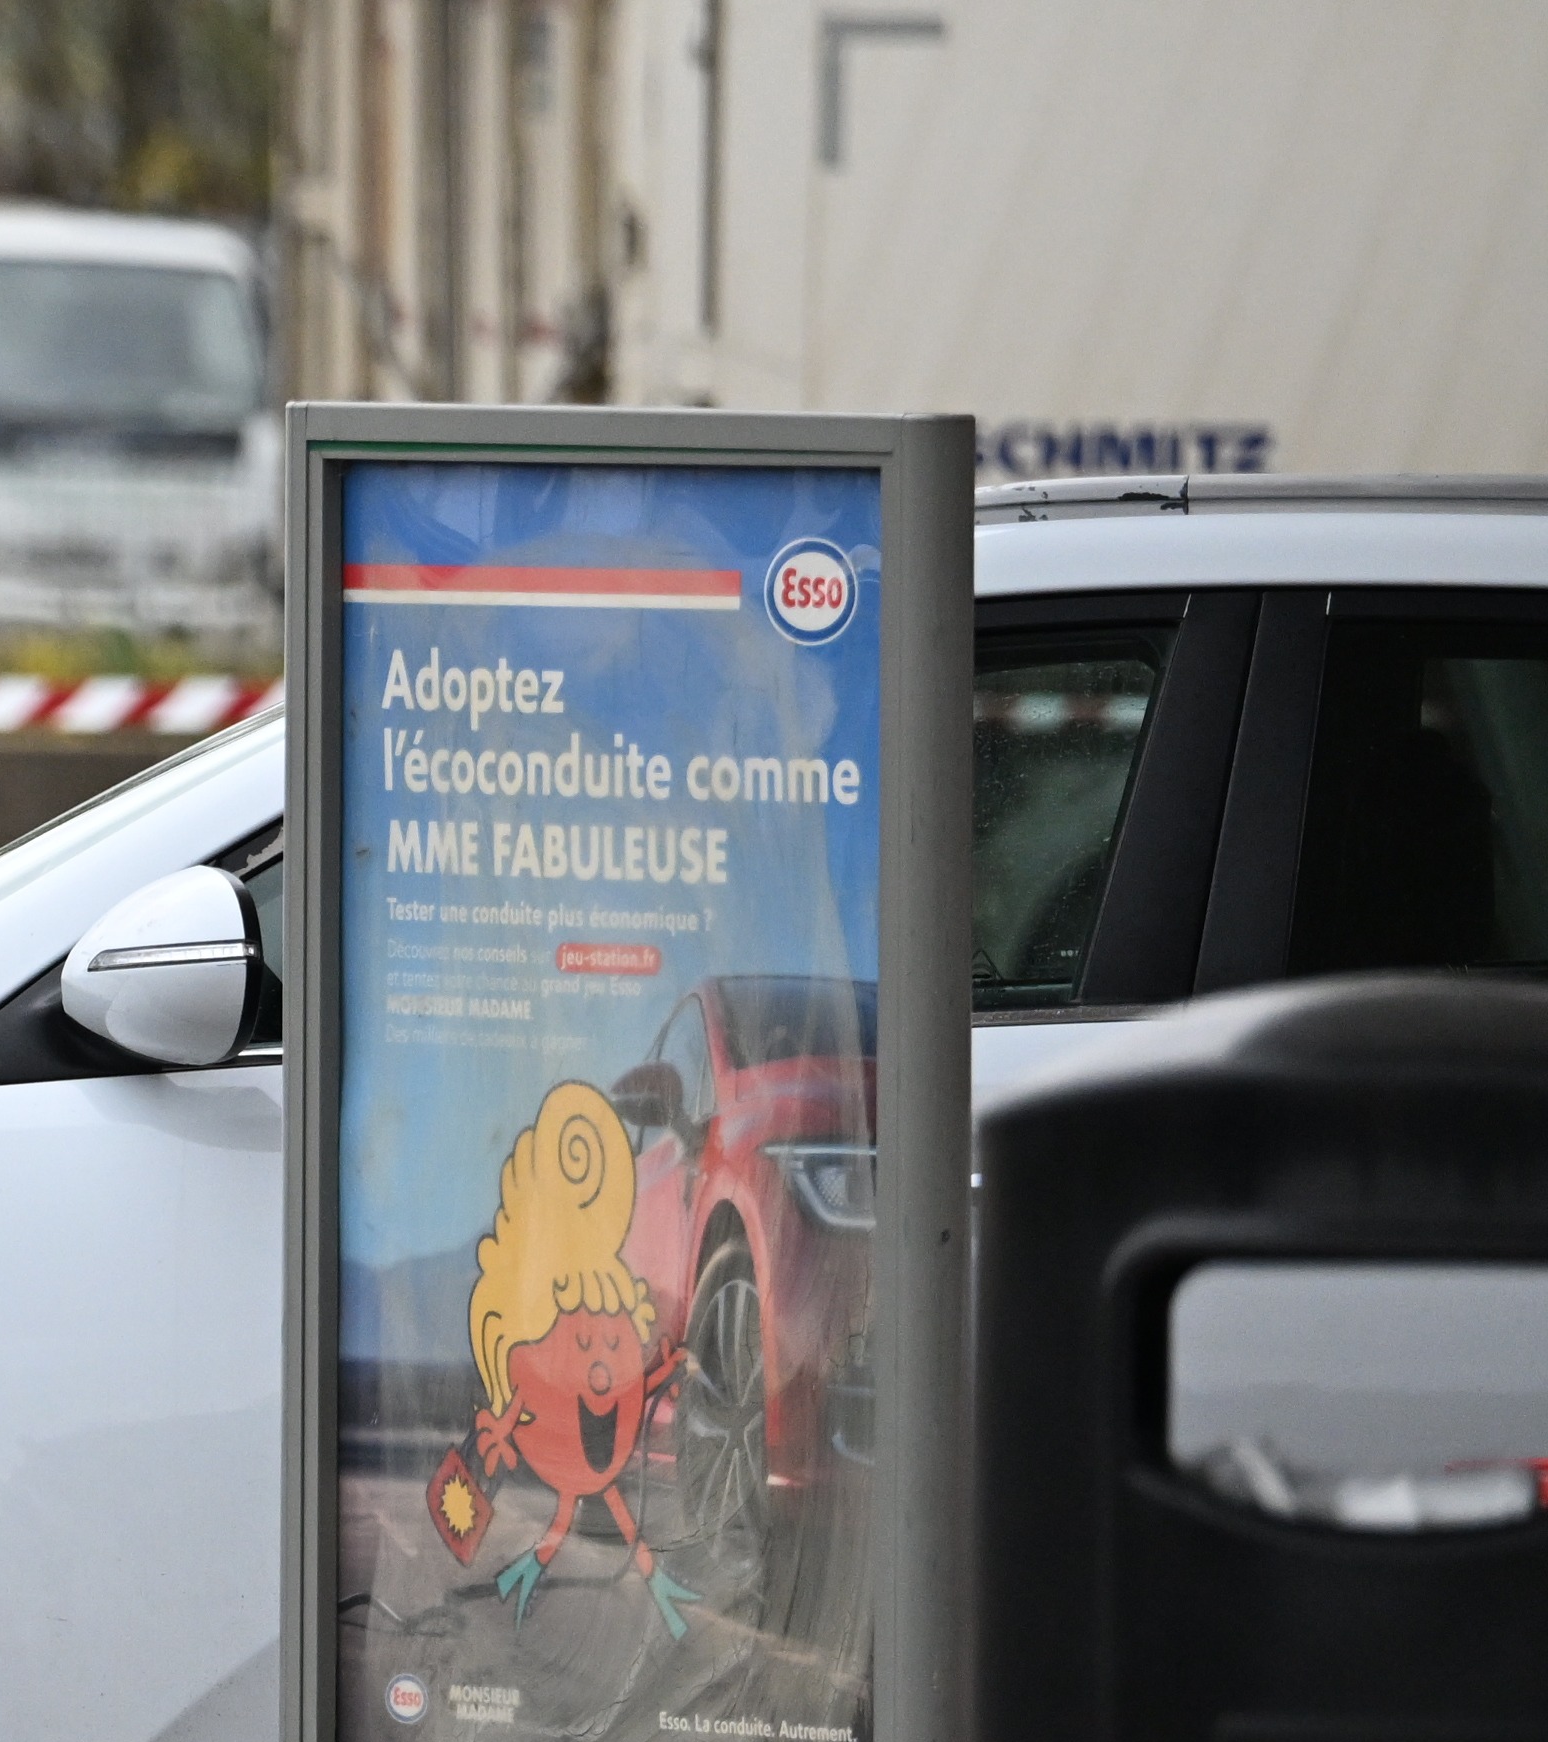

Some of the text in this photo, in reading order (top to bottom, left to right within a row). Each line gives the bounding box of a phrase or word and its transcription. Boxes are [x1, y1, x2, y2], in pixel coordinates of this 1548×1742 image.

[781, 568, 843, 609] Esso
[381, 647, 564, 731] Adoptez
[383, 727, 860, 805] l'écoconduite comme
[387, 819, 727, 883] MME FABULEUSE
[387, 898, 435, 921] Tester
[440, 903, 468, 923] une
[472, 903, 542, 926] conduite
[548, 904, 584, 932] plus
[477, 945, 527, 964] conseils
[561, 945, 655, 970] jeu-station.fr
[449, 1685, 520, 1707] MONSIEUR
[659, 1711, 857, 1742] Esso. La conduite. Autrement.
